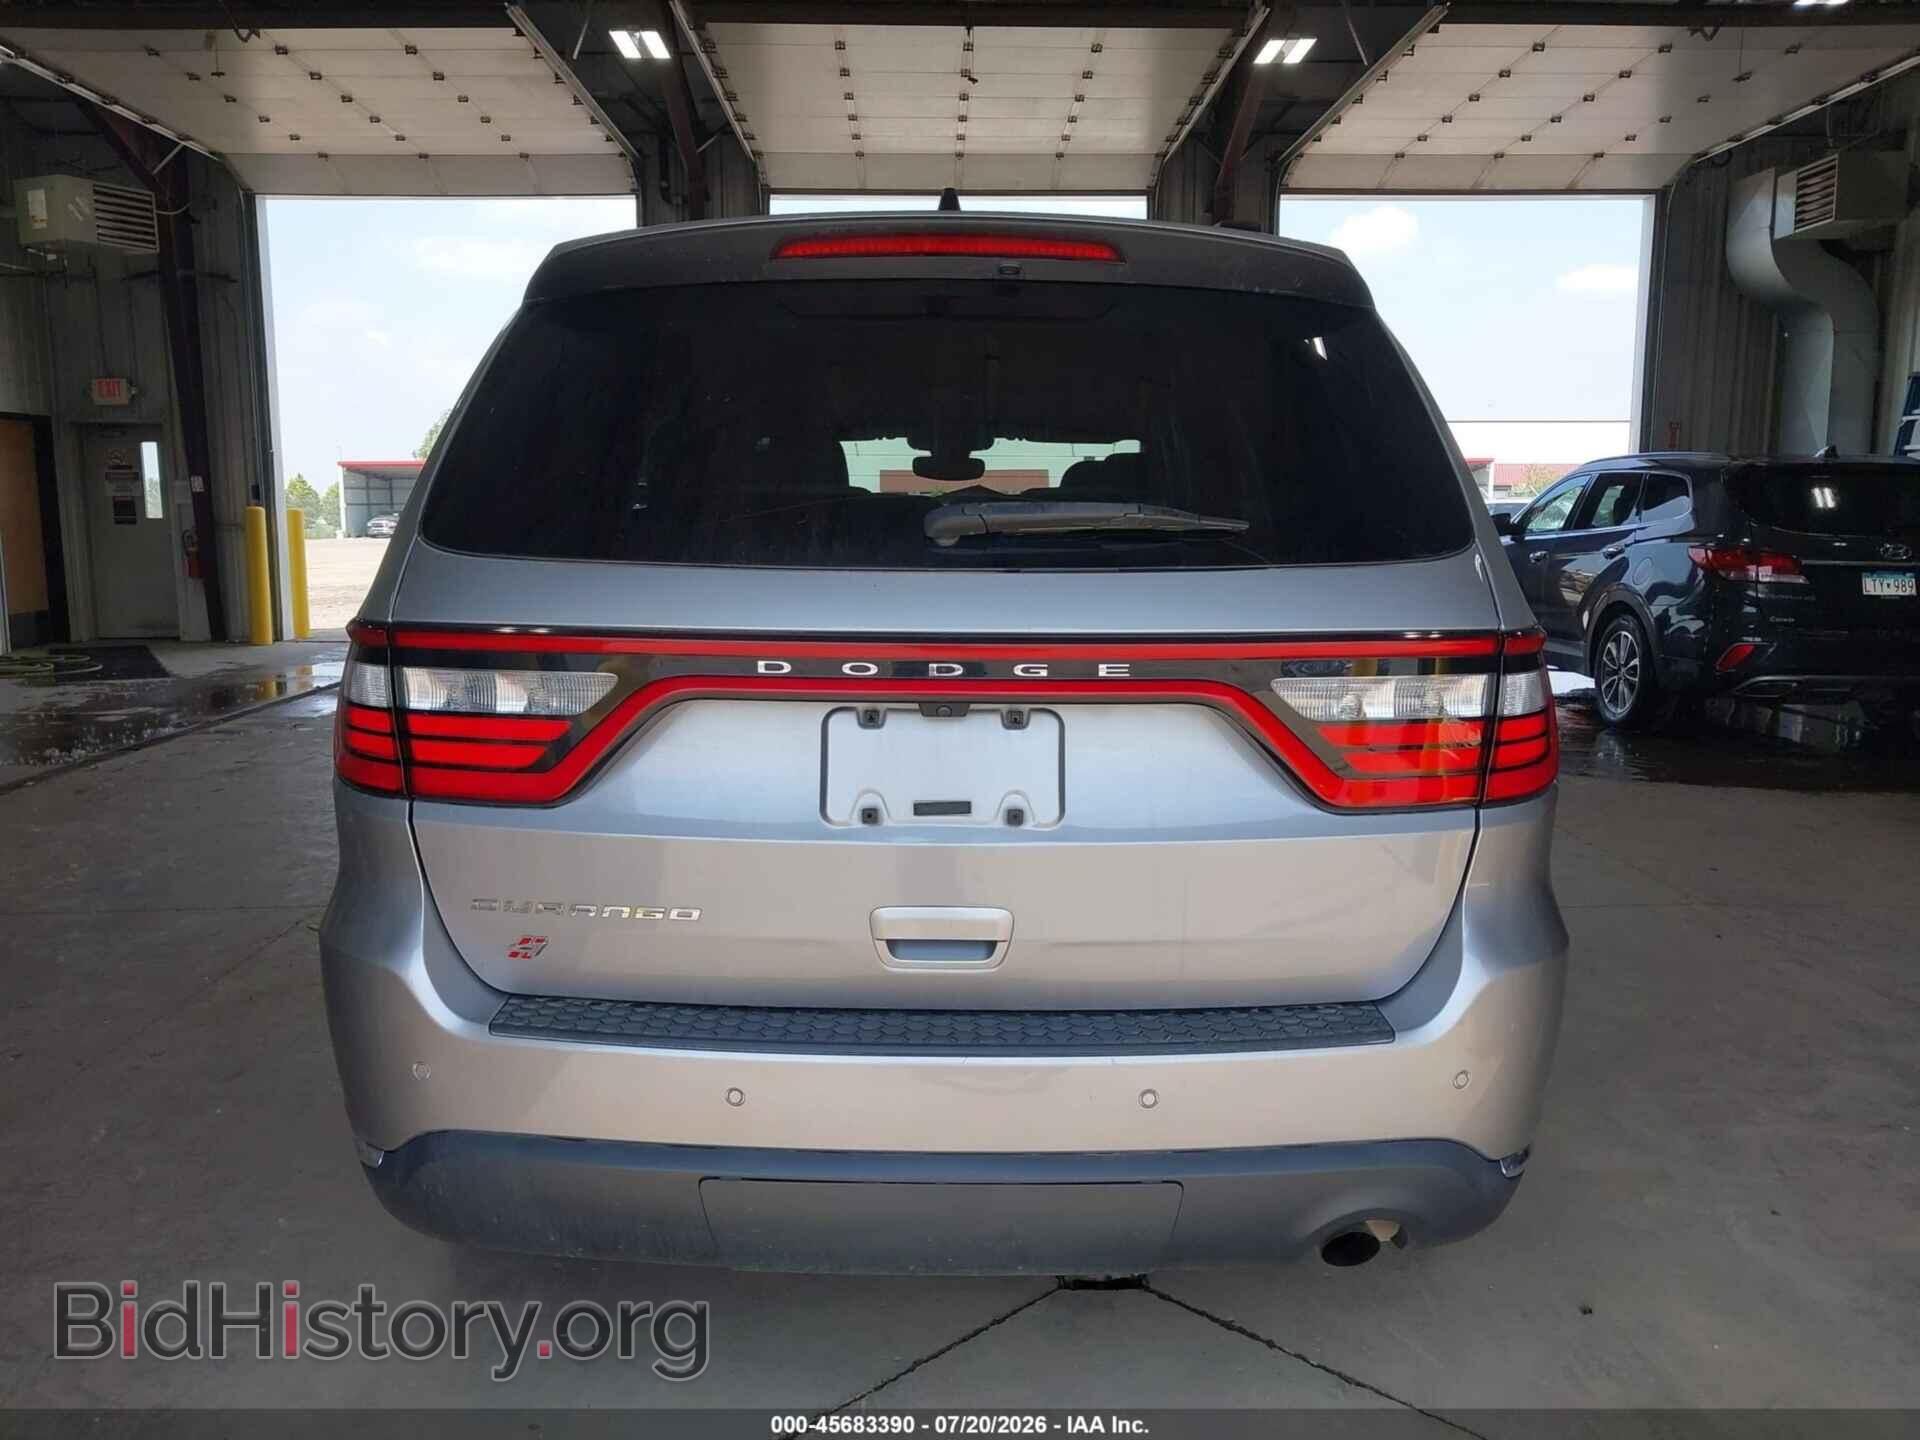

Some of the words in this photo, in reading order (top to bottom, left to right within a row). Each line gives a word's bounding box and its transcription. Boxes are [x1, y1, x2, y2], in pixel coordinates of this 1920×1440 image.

[97, 379, 121, 398] EXIT
[1893, 579, 1914, 593] 989
[757, 660, 1131, 677] DODGE
[471, 899, 702, 921] DURANGO
